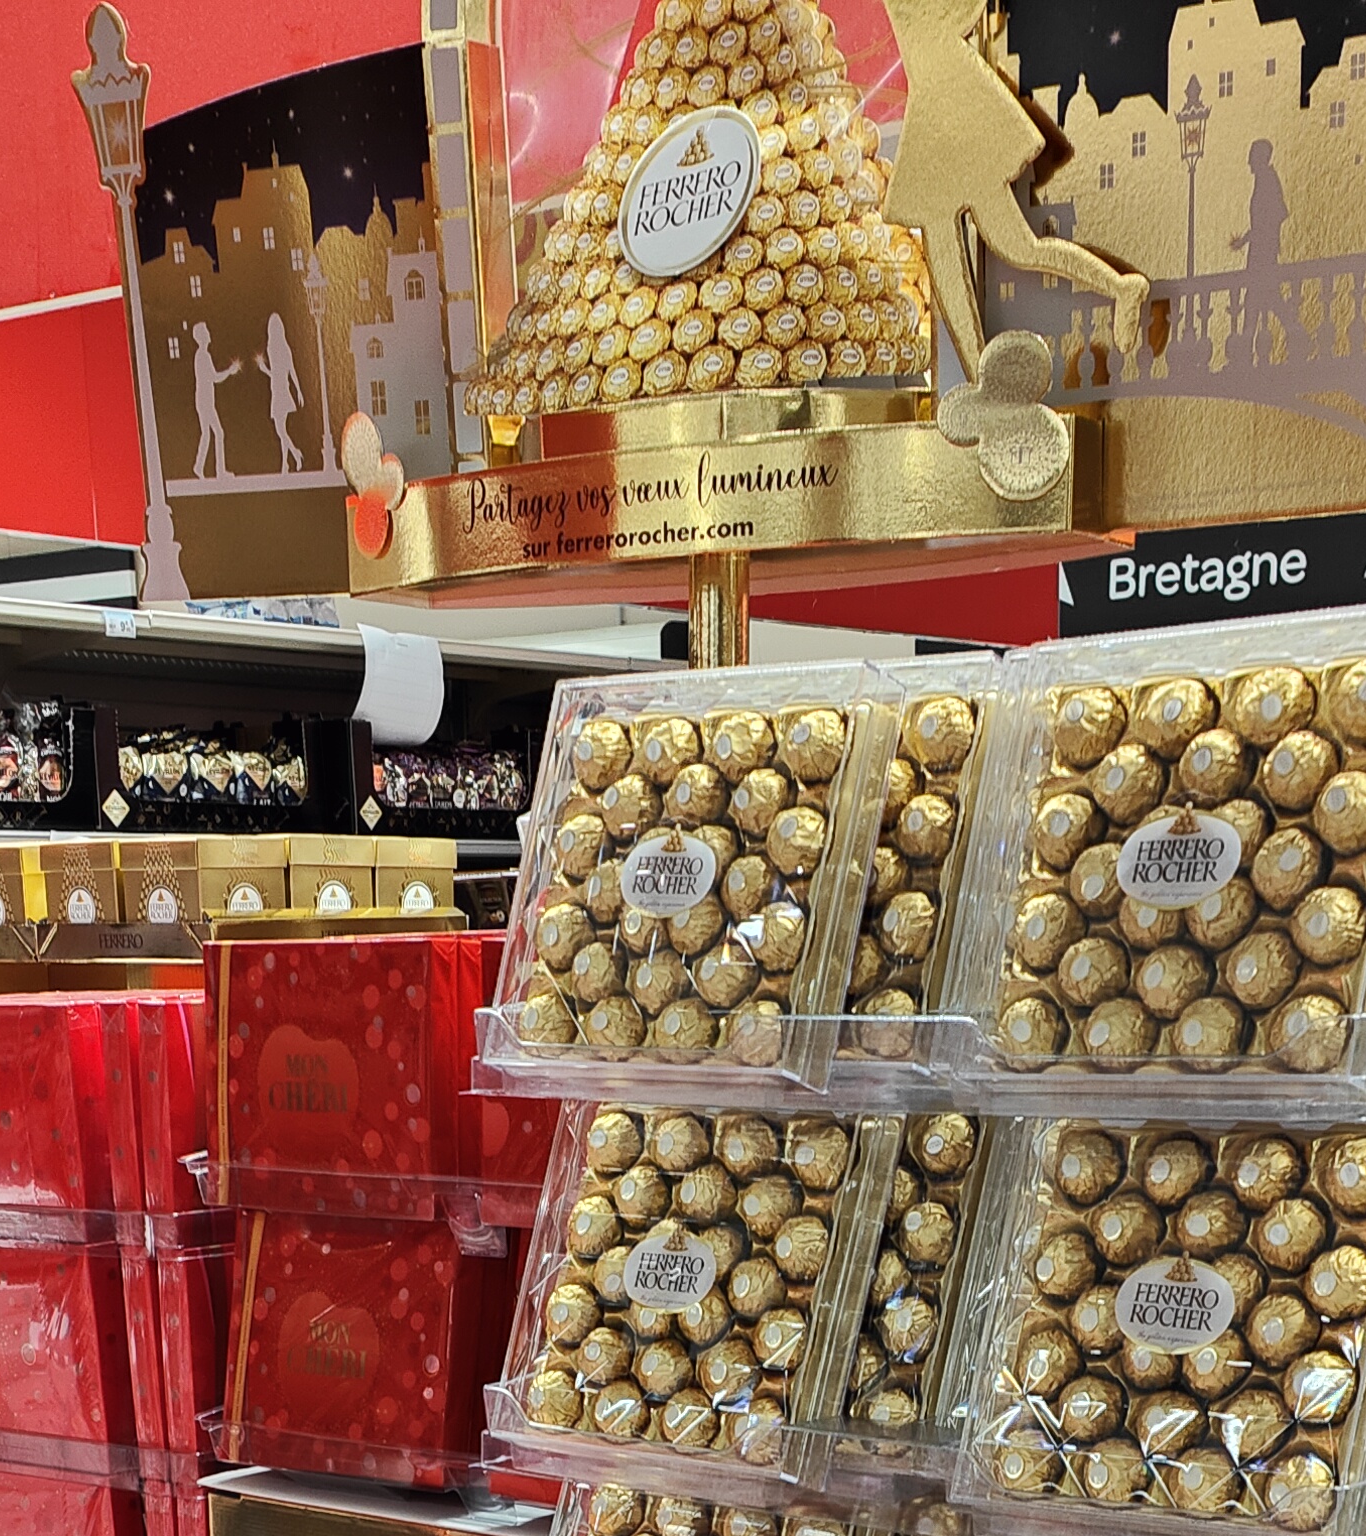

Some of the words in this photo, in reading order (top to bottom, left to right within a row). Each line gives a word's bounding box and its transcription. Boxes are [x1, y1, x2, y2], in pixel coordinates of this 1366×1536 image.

[639, 159, 742, 207] FERRERO
[634, 189, 733, 236] ROCHER
[462, 477, 572, 534] Partagez
[576, 485, 614, 516] vos
[696, 452, 839, 507] lumineux
[521, 539, 550, 559] sur
[555, 517, 754, 553] ferrerorocher.com
[1108, 547, 1309, 602] Bretagne
[1137, 839, 1225, 862] FERRERO
[637, 854, 704, 877] FERRERO
[1132, 861, 1219, 883] ROCHER
[632, 873, 699, 896] ROCHER
[98, 932, 144, 948] FERRERO
[637, 1252, 705, 1275] FERRERO
[634, 1271, 699, 1295] ROCHER
[1133, 1282, 1219, 1309] FERRERO
[1129, 1303, 1213, 1331] ROCHER
